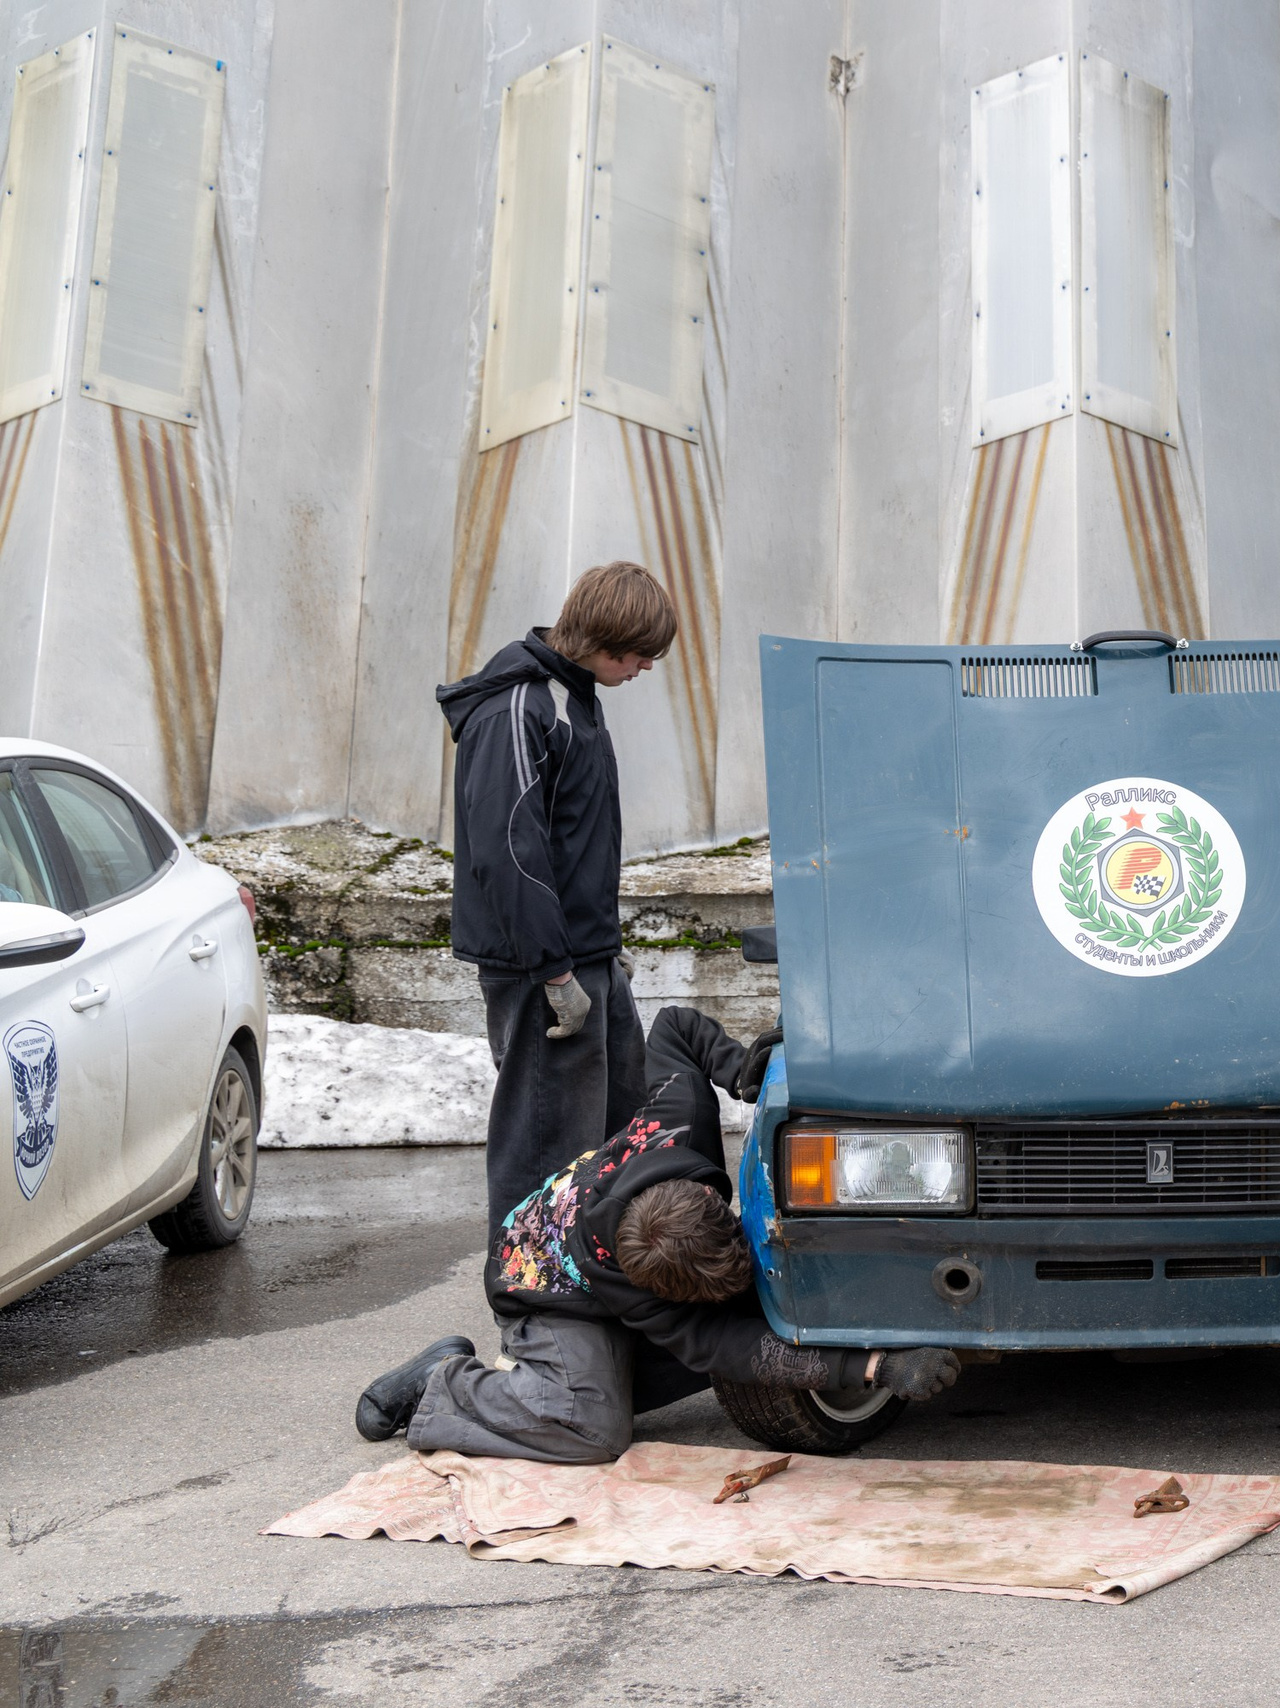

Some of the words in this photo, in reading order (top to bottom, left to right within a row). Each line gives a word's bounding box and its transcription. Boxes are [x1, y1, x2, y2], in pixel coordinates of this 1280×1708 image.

[1084, 787, 1177, 812] Ралликс
[1157, 909, 1229, 965] школьники
[14, 1039, 30, 1049] ЧАСТНОЕ
[29, 1036, 47, 1046] ОХРАННОЕ
